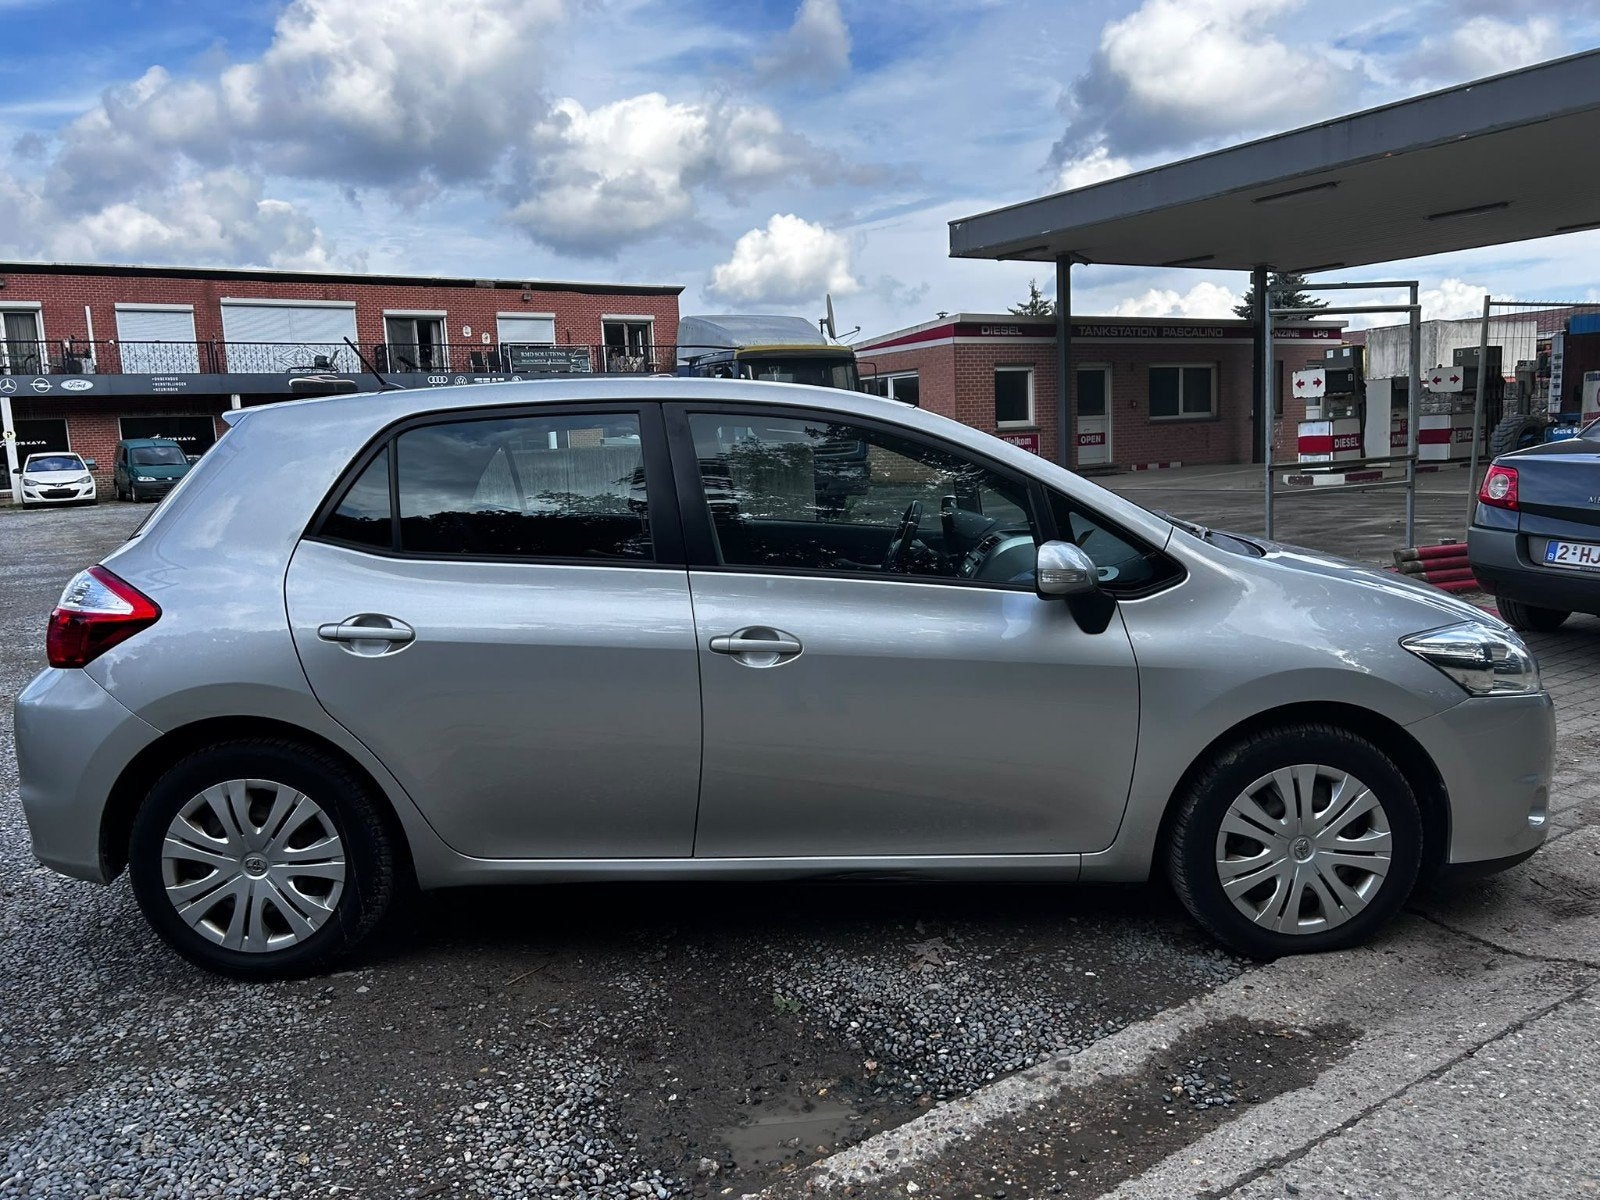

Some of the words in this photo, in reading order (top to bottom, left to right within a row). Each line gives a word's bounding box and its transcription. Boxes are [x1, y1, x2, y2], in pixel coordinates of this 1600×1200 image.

[981, 325, 1023, 335] DIESEL
[1078, 326, 1158, 337] TANKSTATION
[1162, 327, 1224, 337] PASCALINO
[1274, 329, 1300, 338] NZINE
[1312, 330, 1329, 338] LPG
[1080, 434, 1101, 444] OPEN
[1334, 437, 1360, 448] DIESEL
